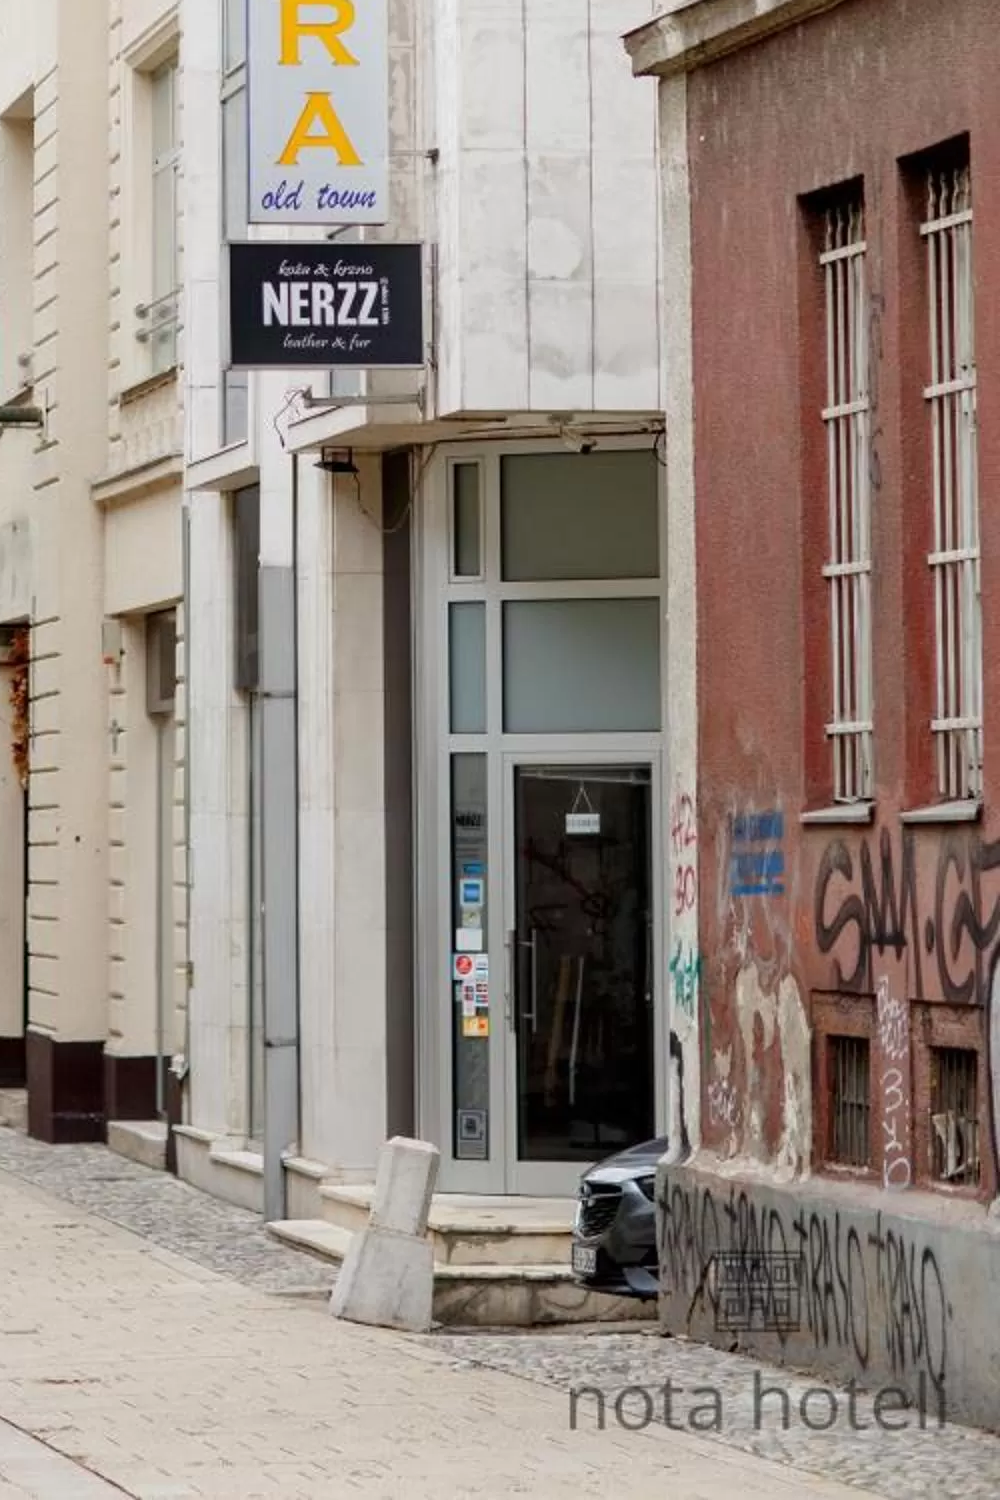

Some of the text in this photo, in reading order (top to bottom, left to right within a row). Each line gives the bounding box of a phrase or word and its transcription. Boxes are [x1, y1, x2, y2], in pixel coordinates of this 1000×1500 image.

[261, 179, 377, 211] old town
[313, 263, 330, 277] &
[262, 281, 379, 327] NERZZ
[283, 333, 372, 351] leather & fur
